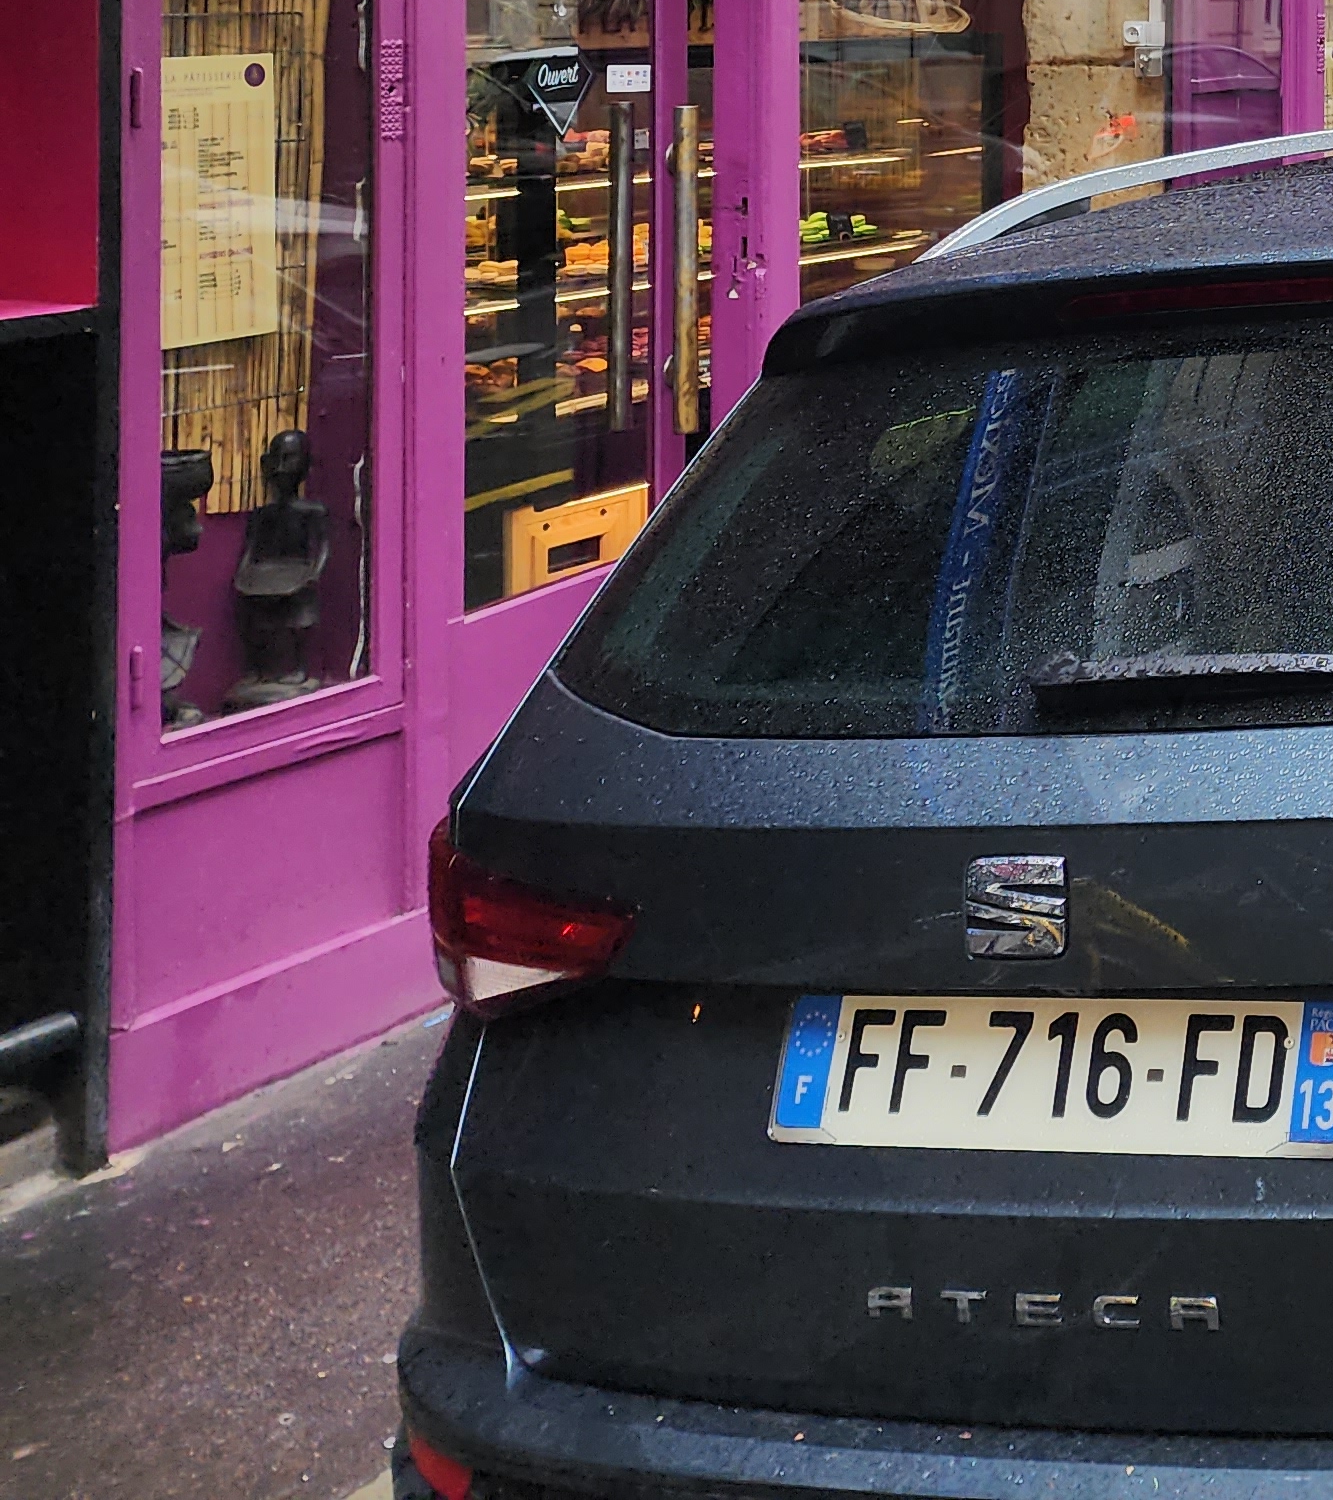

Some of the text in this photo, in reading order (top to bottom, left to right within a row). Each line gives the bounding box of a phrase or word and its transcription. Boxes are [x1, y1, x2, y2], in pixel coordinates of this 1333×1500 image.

[538, 62, 579, 87] Ouvert
[838, 1008, 1290, 1124] FF-716-FD
[795, 1075, 813, 1105] F
[868, 1286, 1220, 1332] ATECA
